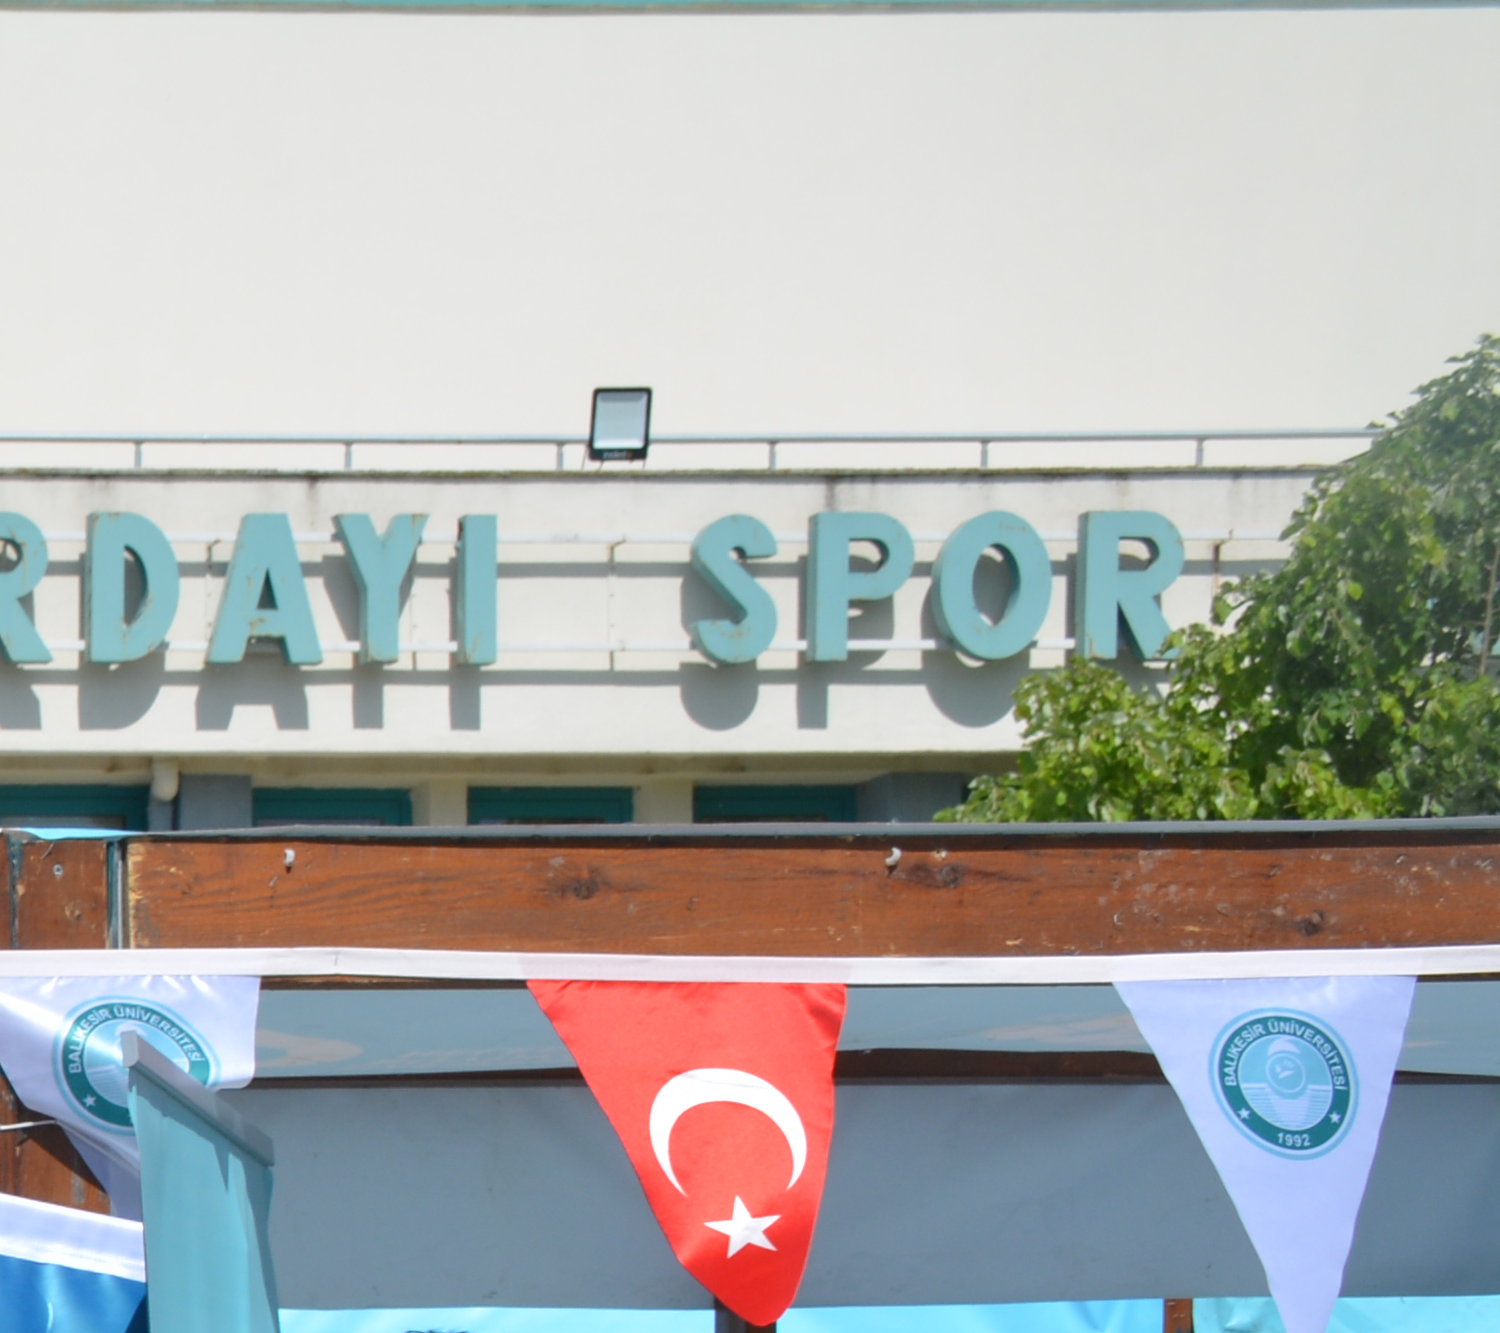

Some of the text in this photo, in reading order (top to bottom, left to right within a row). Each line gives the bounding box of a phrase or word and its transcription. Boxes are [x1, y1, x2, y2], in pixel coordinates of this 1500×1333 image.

[687, 511, 1184, 665] SPOR
[68, 1004, 206, 1074] BALIKESİR ÜNİVERSİTESİ
[1224, 1018, 1348, 1091] BALIKESİR ÜNİVERSİTESİ
[1276, 1131, 1312, 1148] 1992
